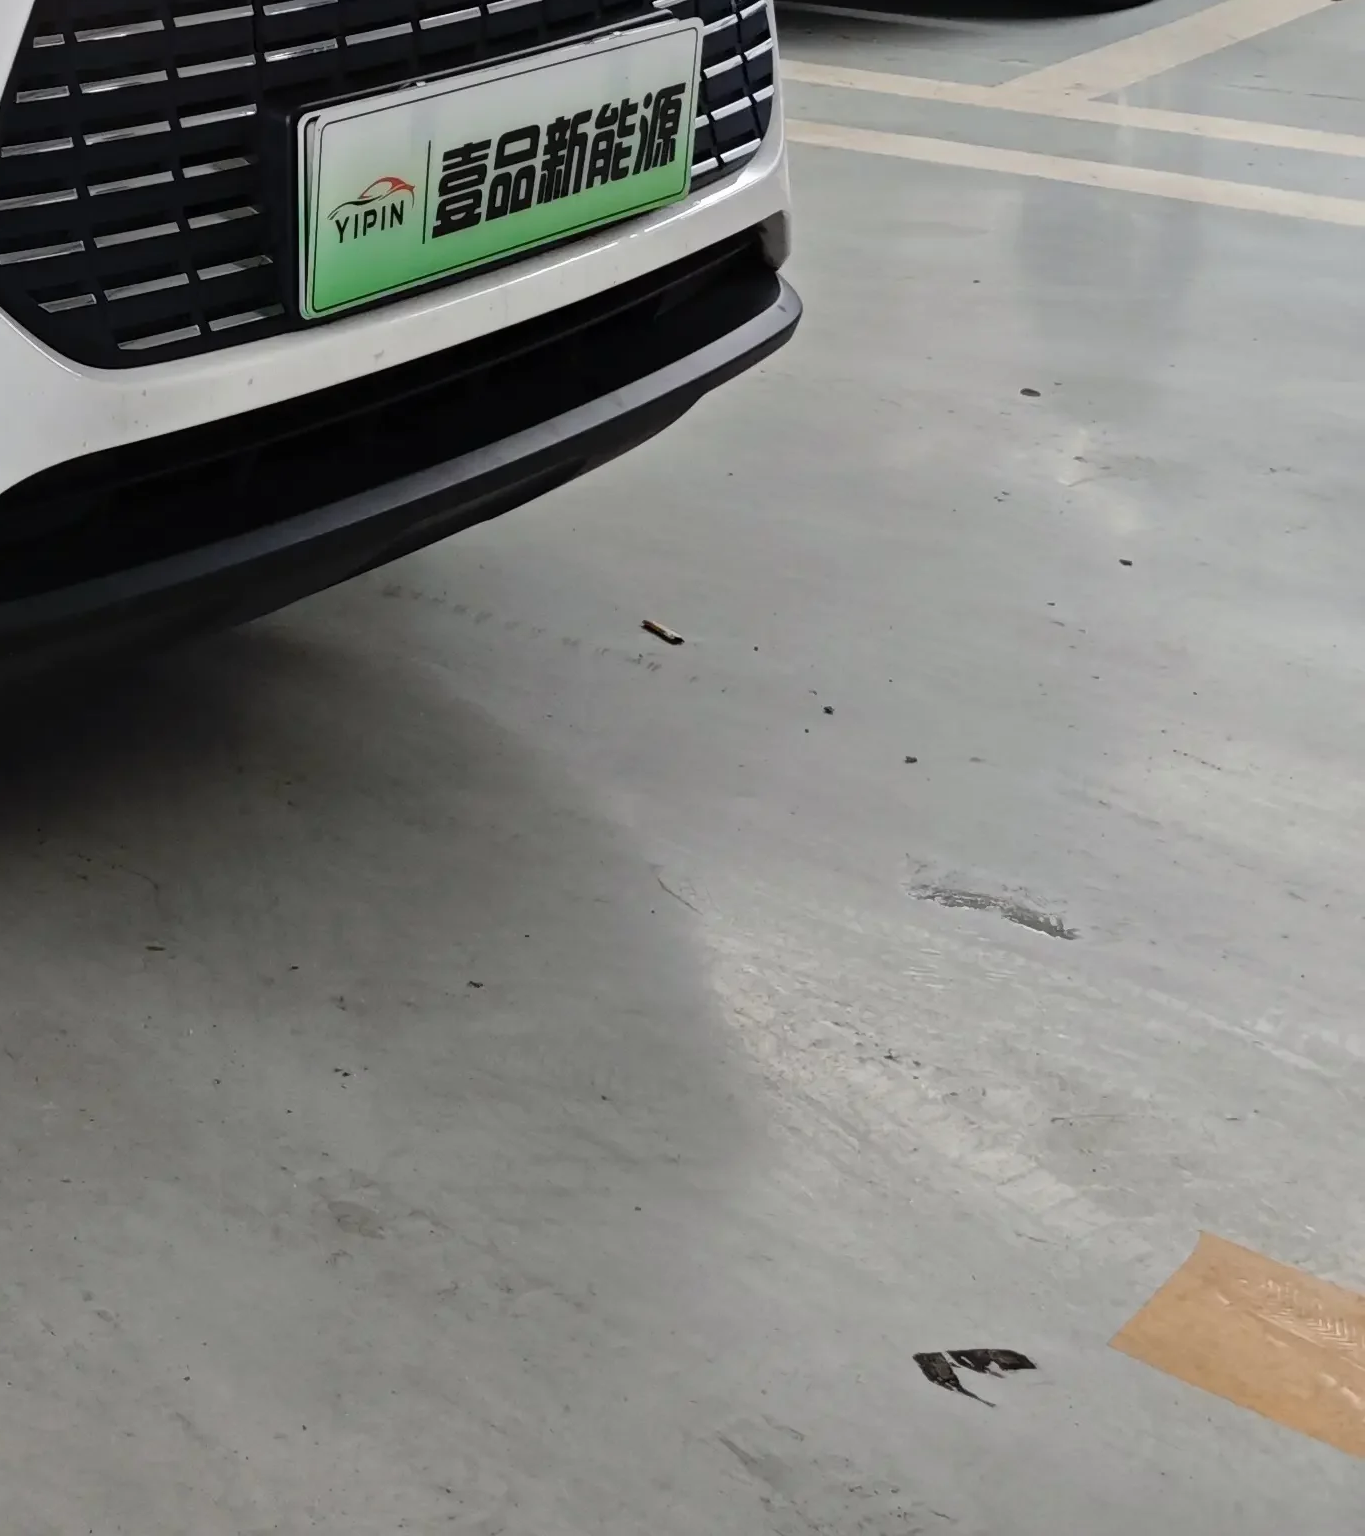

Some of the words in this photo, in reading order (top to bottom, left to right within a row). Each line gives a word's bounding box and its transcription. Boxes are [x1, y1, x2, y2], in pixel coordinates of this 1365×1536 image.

[431, 81, 687, 240] 壹品新能源
[334, 199, 405, 244] YIPIN
